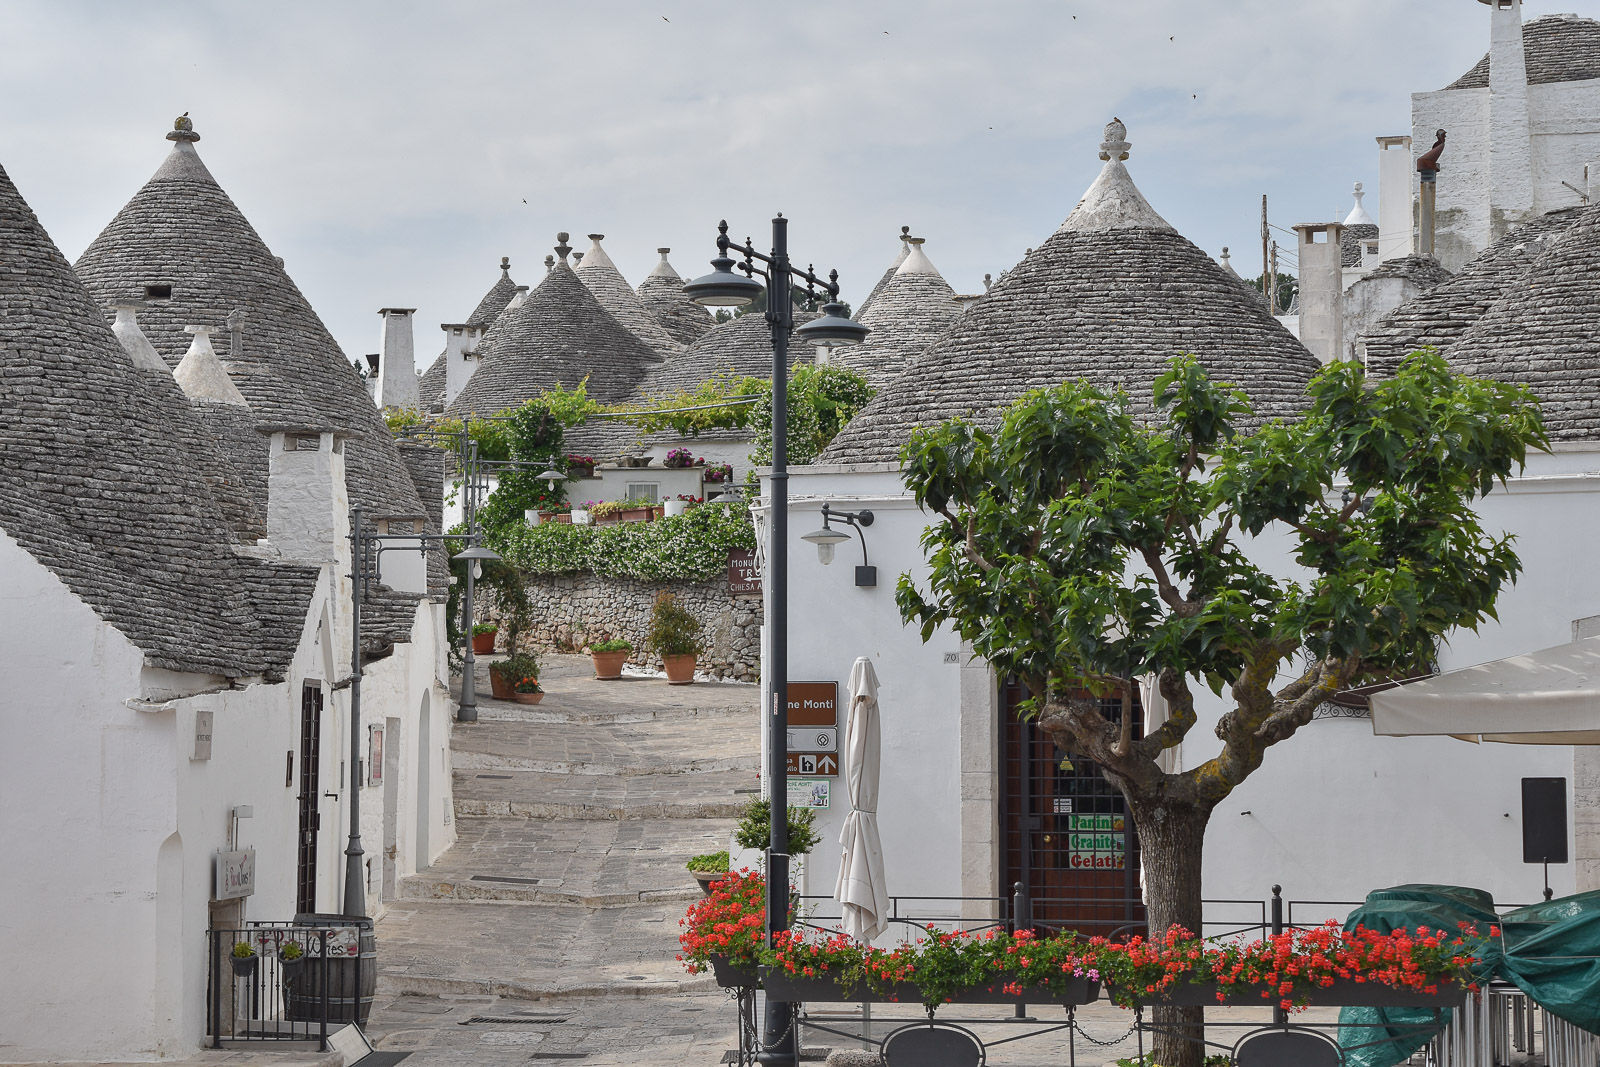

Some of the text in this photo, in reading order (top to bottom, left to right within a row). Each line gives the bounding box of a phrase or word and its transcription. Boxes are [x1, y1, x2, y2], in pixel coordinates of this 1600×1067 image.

[730, 583, 755, 591] CHIESA
[945, 653, 956, 662] 70
[803, 699, 833, 709] Monti
[1070, 815, 1114, 829] Panini
[1070, 834, 1116, 849] Granite
[1070, 854, 1117, 868] Gelati
[307, 936, 344, 956] Wnes
